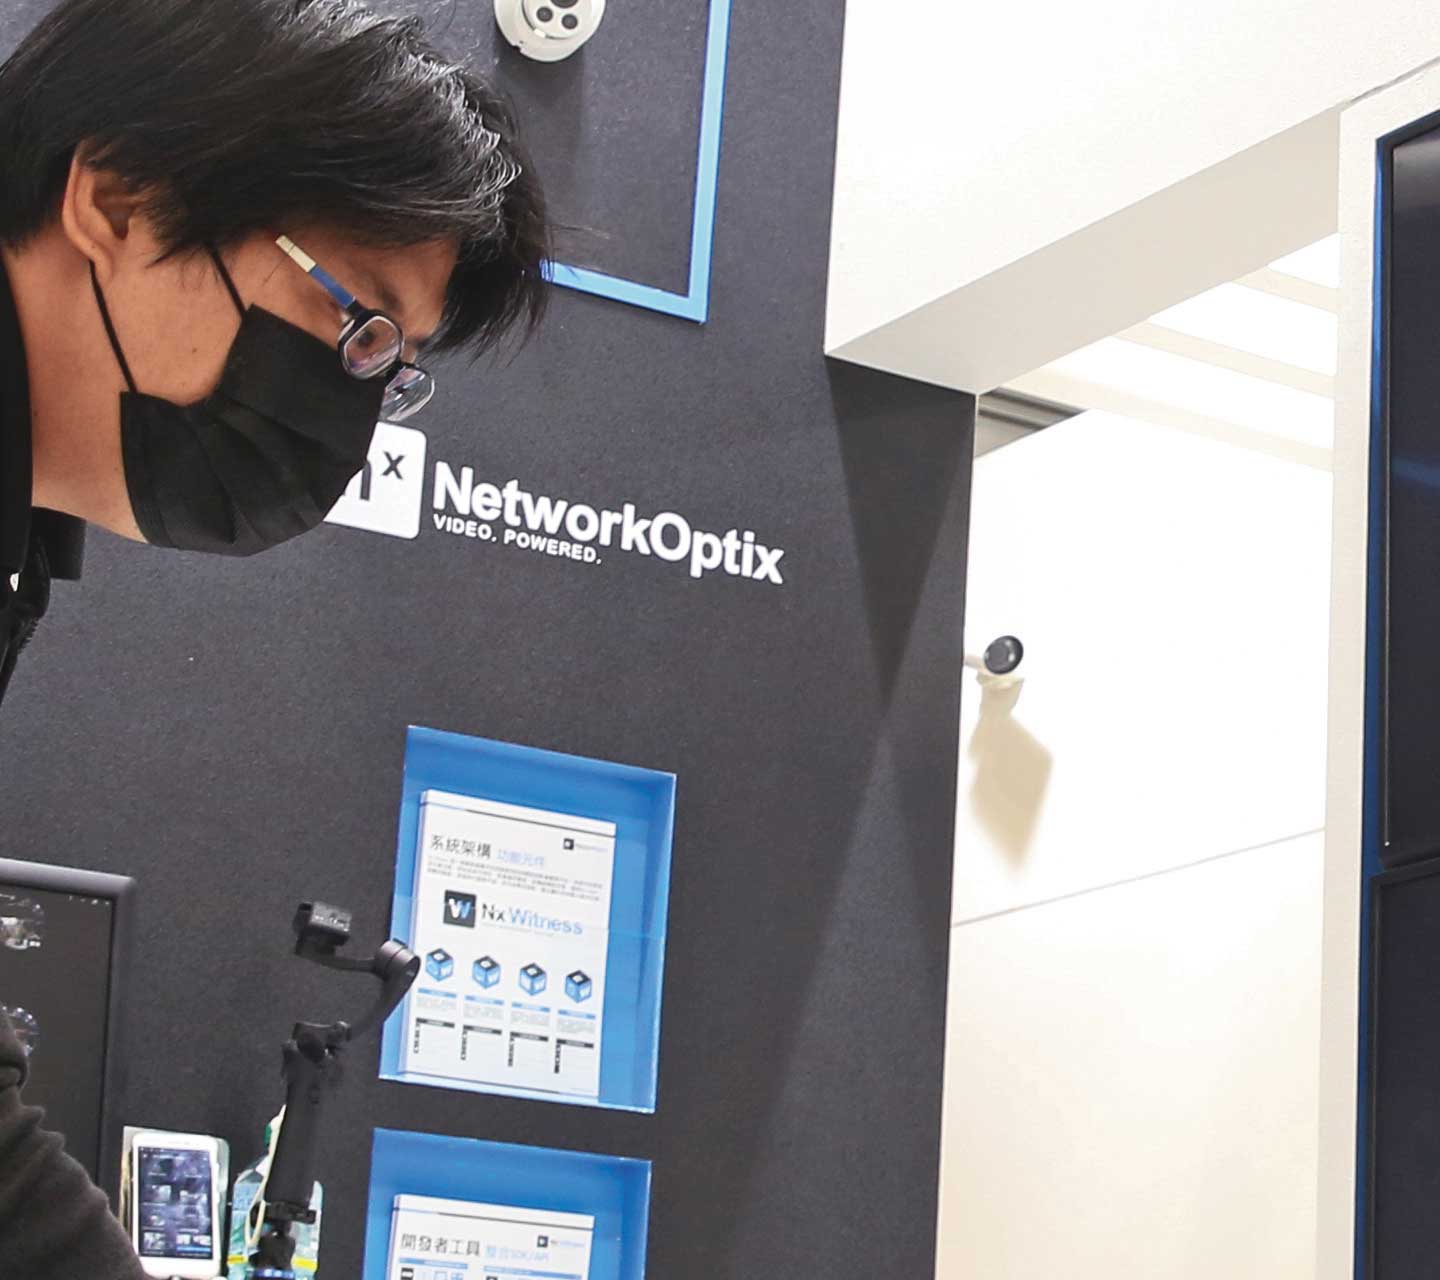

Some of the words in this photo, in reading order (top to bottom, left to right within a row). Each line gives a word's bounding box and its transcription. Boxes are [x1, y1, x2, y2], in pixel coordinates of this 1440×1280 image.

[432, 460, 785, 585] NetworkOptix
[432, 512, 498, 543] VIDEO.
[503, 528, 603, 565] POWERED.
[481, 902, 507, 923] Nx
[509, 906, 584, 936] Witness
